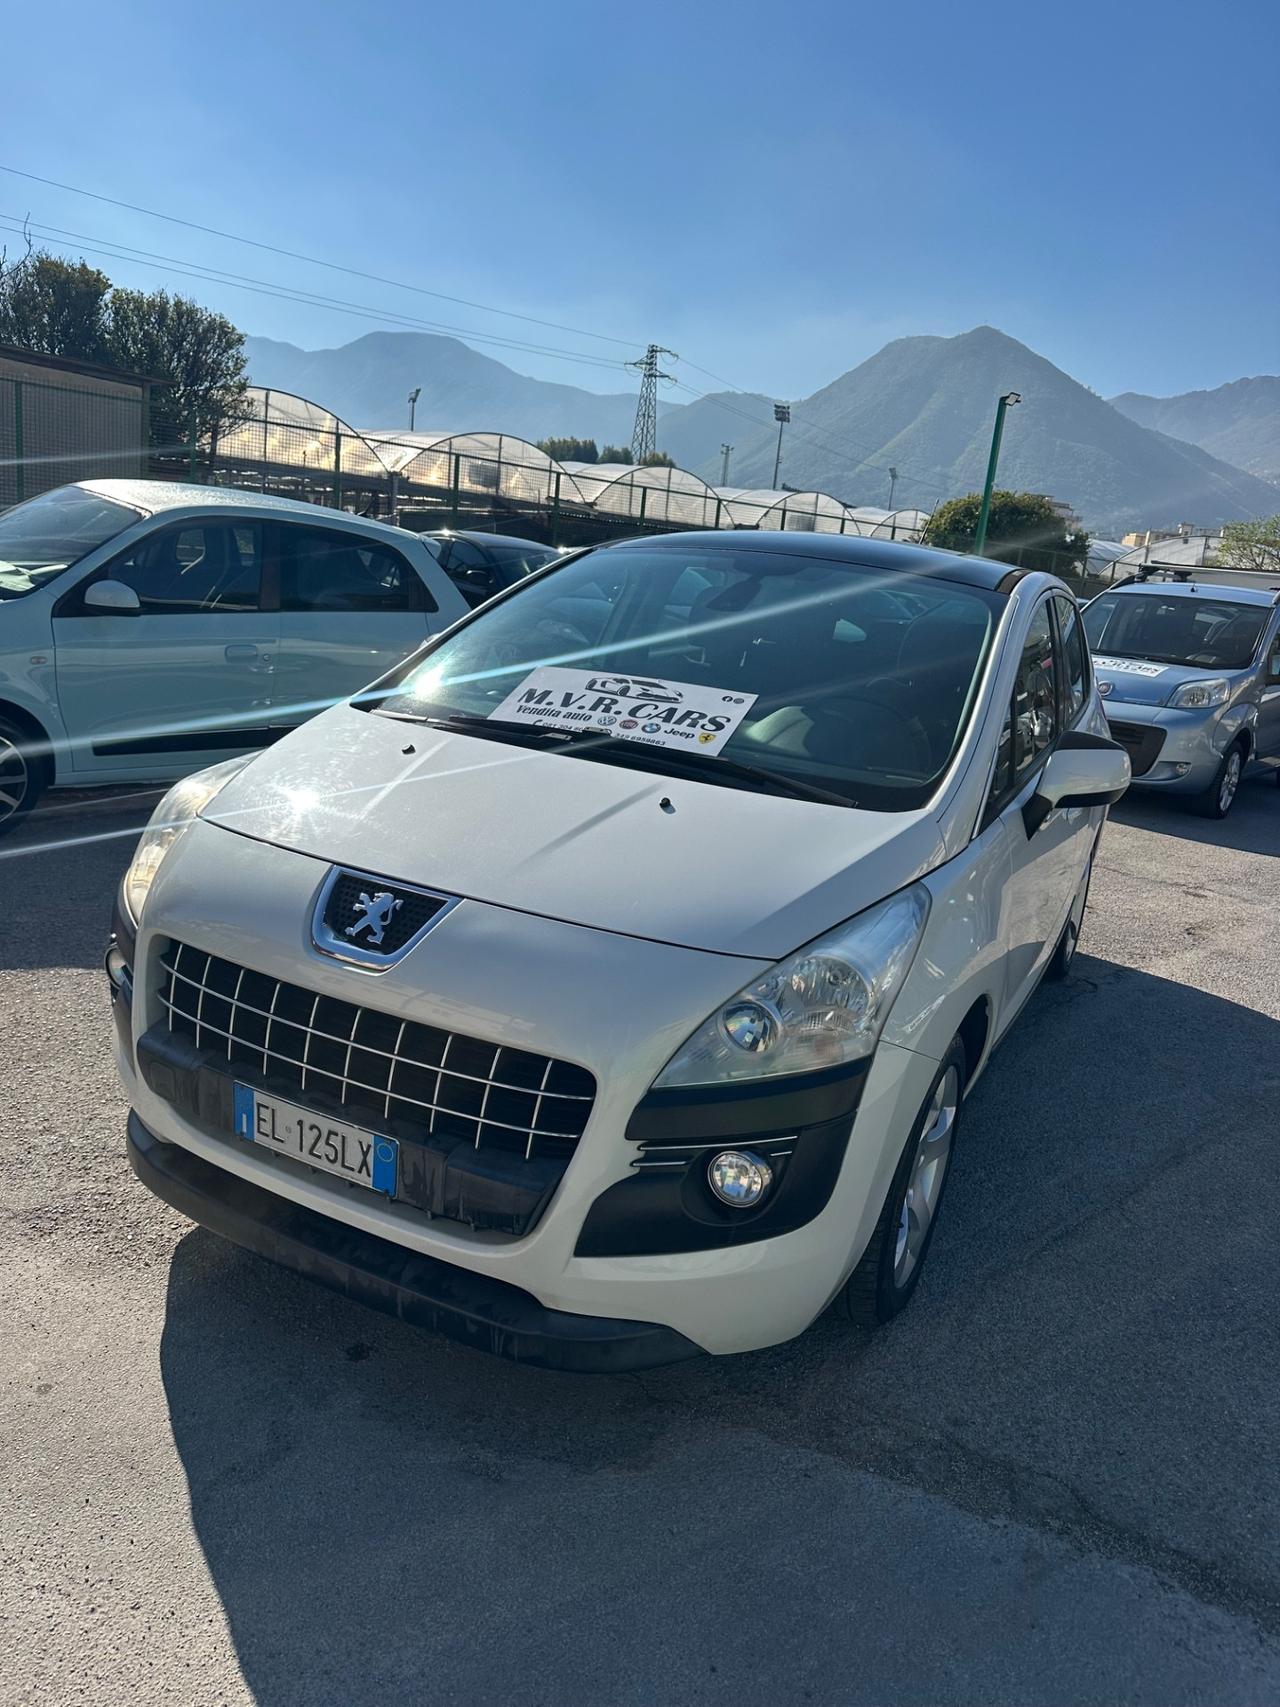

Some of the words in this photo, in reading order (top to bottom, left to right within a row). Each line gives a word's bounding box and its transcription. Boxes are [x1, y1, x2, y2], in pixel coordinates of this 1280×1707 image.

[516, 705, 562, 718] Vendita
[562, 711, 593, 722] auto
[664, 728, 695, 739] Jeep
[256, 1102, 285, 1144] EL
[297, 1119, 372, 1178] 125LX
